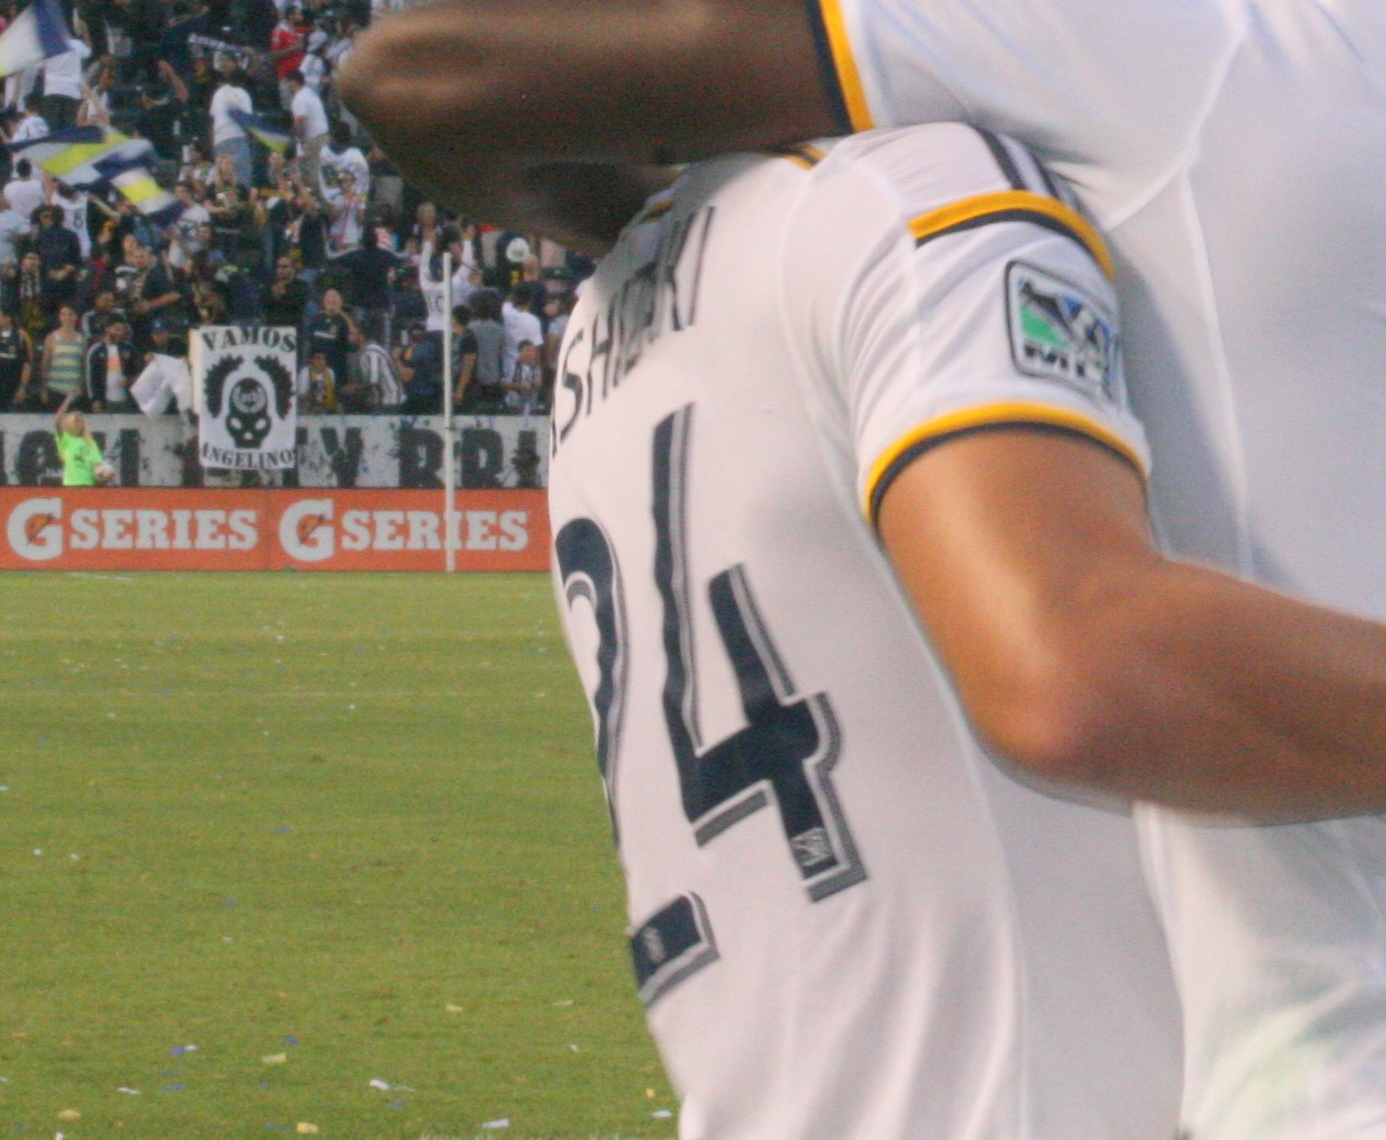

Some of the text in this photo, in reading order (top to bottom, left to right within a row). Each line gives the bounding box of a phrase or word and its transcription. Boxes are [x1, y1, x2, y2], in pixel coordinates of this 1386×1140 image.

[202, 326, 297, 352] VAMOS
[7, 497, 258, 561] G SERIES
[279, 498, 335, 562] G
